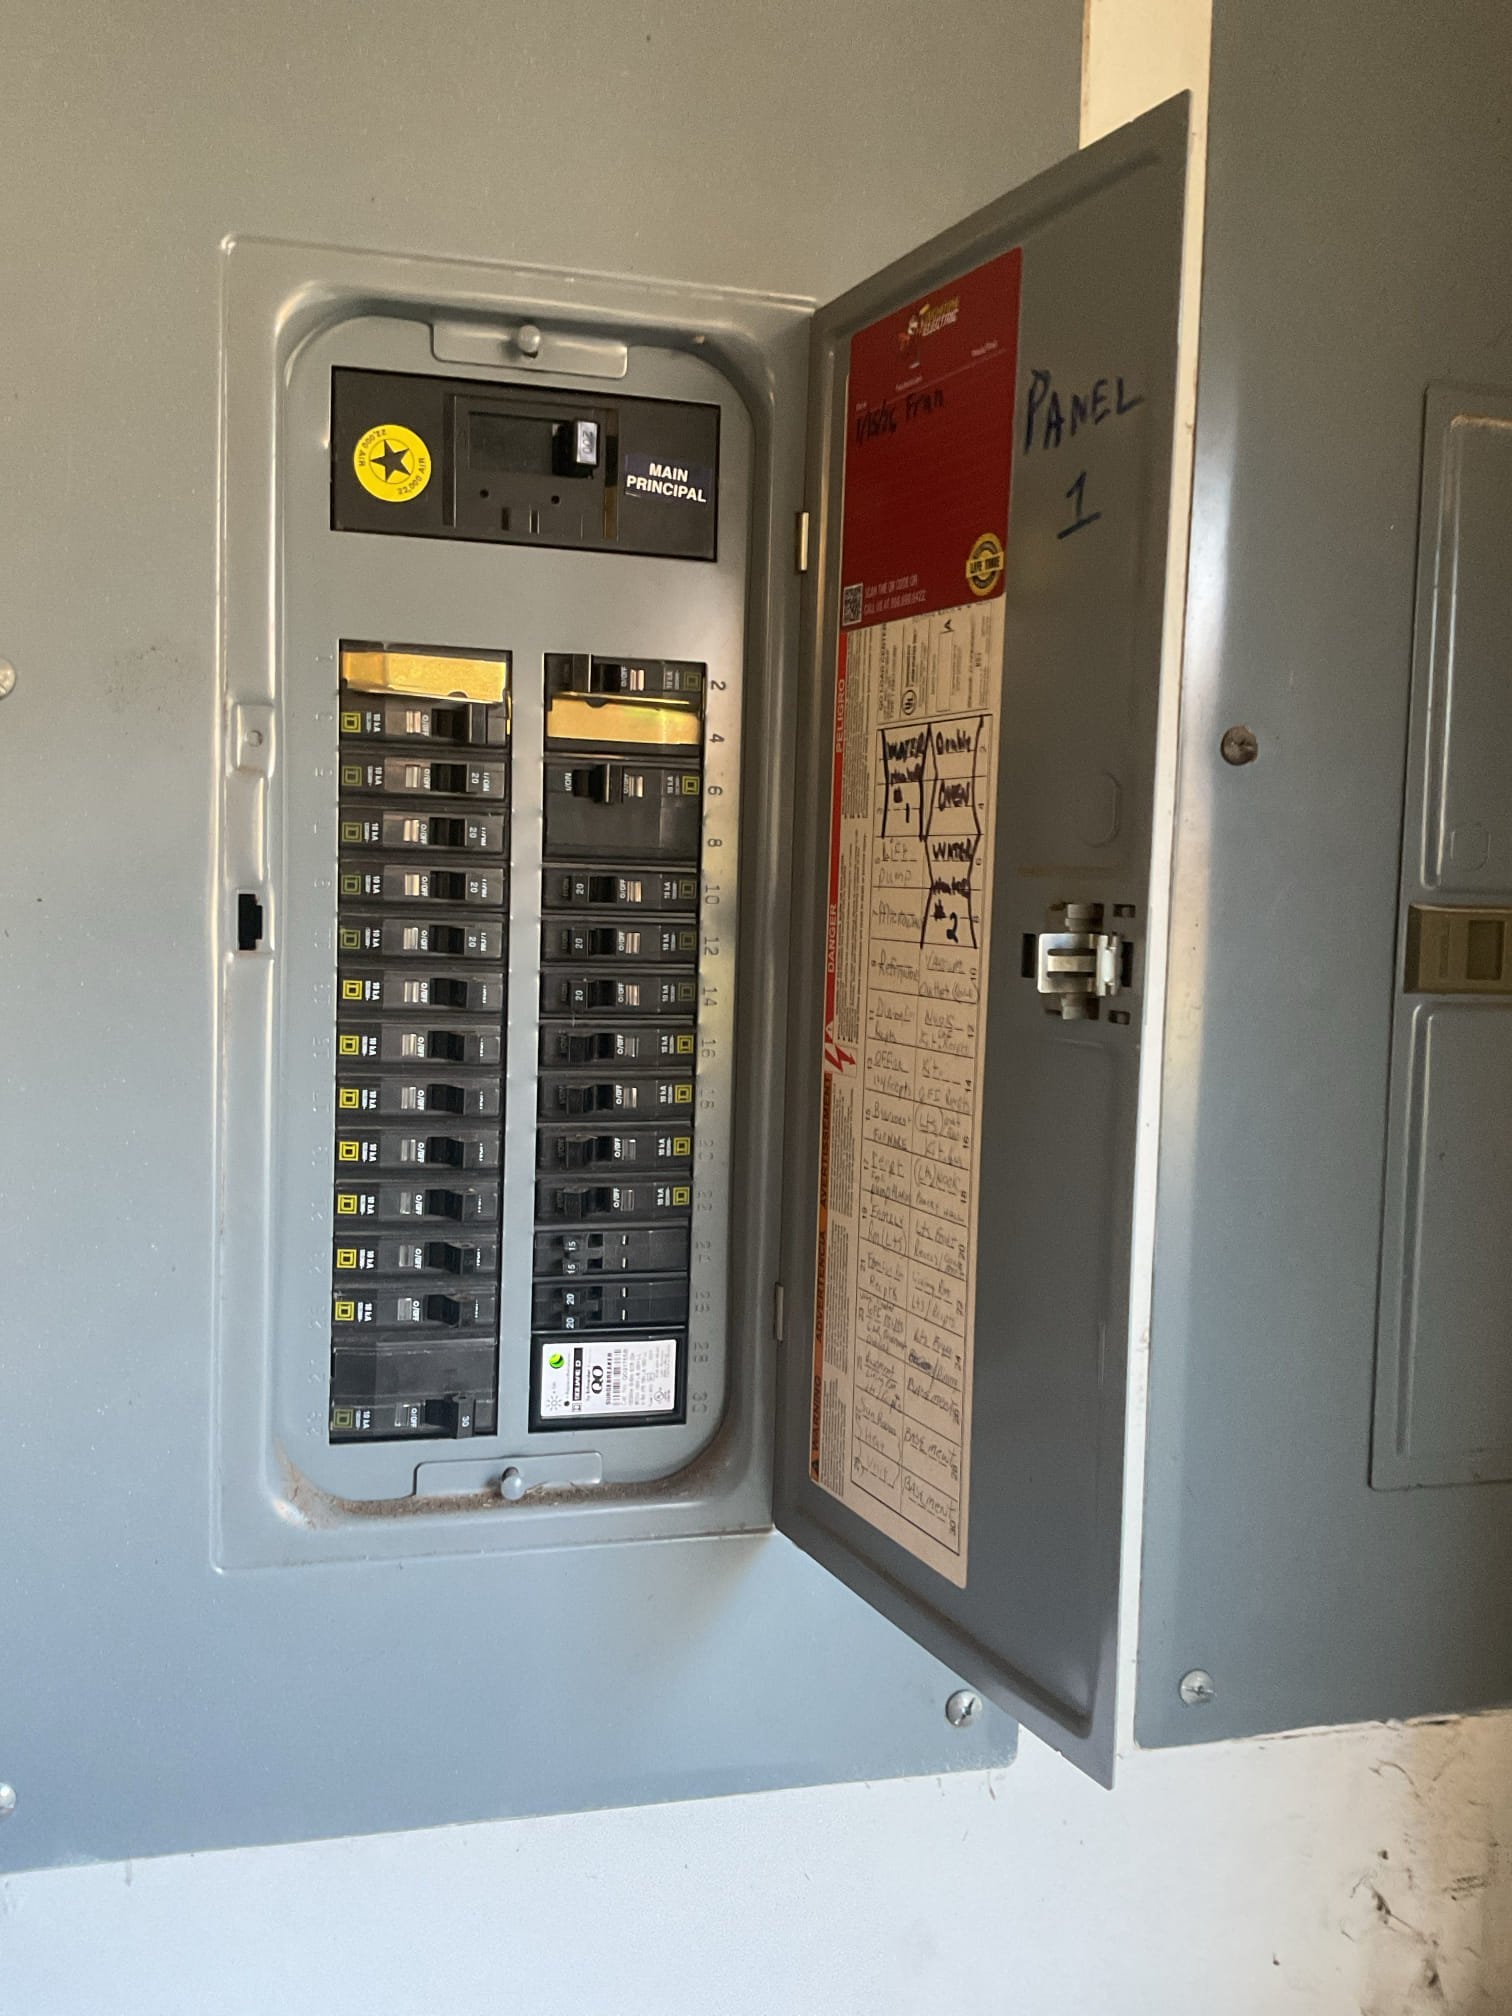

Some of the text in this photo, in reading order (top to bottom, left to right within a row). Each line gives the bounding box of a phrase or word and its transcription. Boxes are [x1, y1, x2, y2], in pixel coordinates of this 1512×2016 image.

[1023, 369, 1144, 456] PANEL
[361, 429, 387, 449] 22,000
[583, 431, 594, 455] 200
[648, 462, 689, 483] MAIN
[397, 475, 423, 495] 22,000
[626, 474, 707, 503] PRINCIPAL
[1056, 471, 1102, 540] 1
[711, 680, 726, 691] 2
[836, 679, 845, 753] PELIGRO
[710, 734, 724, 744] 4
[472, 772, 480, 784] 20
[708, 785, 722, 796] 6
[470, 826, 477, 838] 20
[708, 838, 722, 848] 8
[470, 882, 478, 893] 20
[576, 883, 584, 894] 20
[705, 886, 720, 904] 10
[945, 911, 959, 943] 2
[468, 936, 476, 948] 20
[576, 938, 583, 949] 20
[704, 937, 718, 956] 12
[828, 903, 837, 974] DANGER
[576, 990, 584, 1000] 20
[702, 988, 718, 1007] 14
[820, 1073, 832, 1209] AVERTISSEMENT
[568, 1240, 576, 1251] 15
[568, 1264, 576, 1274] 15
[816, 1231, 826, 1343] ADVERTENCIA
[566, 1293, 574, 1304] 20
[566, 1317, 574, 1328] 20
[591, 1365, 604, 1394] QO
[812, 1376, 821, 1451] WARNING
